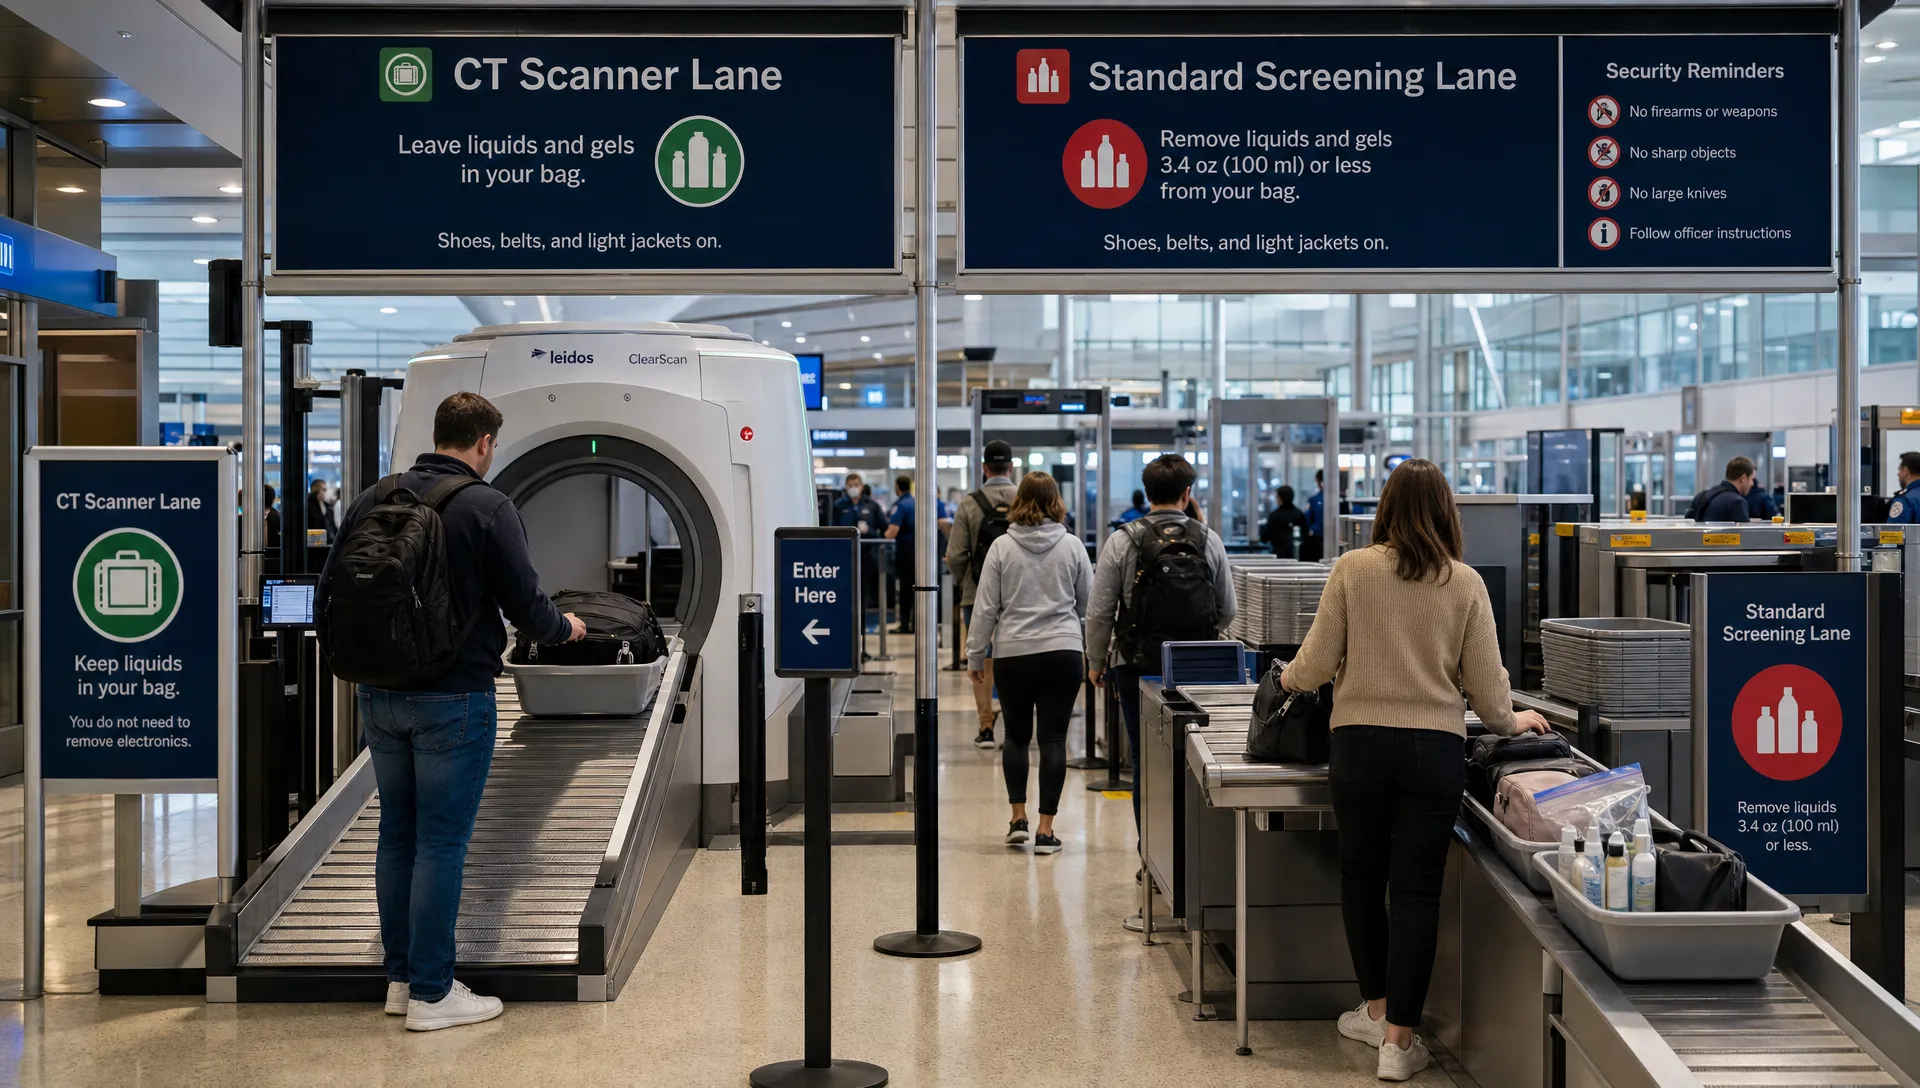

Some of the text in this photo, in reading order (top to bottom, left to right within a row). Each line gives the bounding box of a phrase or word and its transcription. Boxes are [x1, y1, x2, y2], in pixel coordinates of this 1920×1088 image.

[455, 57, 782, 90] CT Scanner Lane
[1089, 61, 1516, 97] Standard Screening Lane
[1607, 63, 1784, 82] Security Reminders
[1630, 105, 1777, 119] No firearms or weapons
[399, 135, 634, 159] Leave liquids and gels
[1162, 130, 1392, 151] Remove liquids and gels
[1631, 147, 1736, 161] No sharp objects
[1161, 156, 1371, 176] 3.4 oz (100 ml) or less
[462, 164, 585, 188] in your bag.
[1160, 182, 1299, 203] from your bag.
[1630, 187, 1726, 202] No large knives
[1631, 227, 1791, 239] Follow officer instructions
[438, 232, 721, 252] Shoes, belts, and light jackets on.
[1104, 234, 1388, 254] Shoes, belts, and light jackets on.
[551, 351, 593, 364] leidos
[629, 354, 687, 364] ClearScan
[57, 493, 201, 509] CT Scanner Lane
[794, 562, 840, 578] Enter
[796, 587, 836, 603] Here
[1747, 603, 1824, 619] Standard
[1723, 626, 1850, 644] Screening Lane
[75, 655, 182, 675] Keep liquids
[78, 679, 179, 699] in your bag.
[69, 716, 190, 728] You do not need to
[67, 735, 191, 747] remove electronics.
[1739, 801, 1836, 816] Remove liquids
[1738, 819, 1838, 834] 3.4 oz (100 ml)
[1766, 839, 1811, 851] or less.
